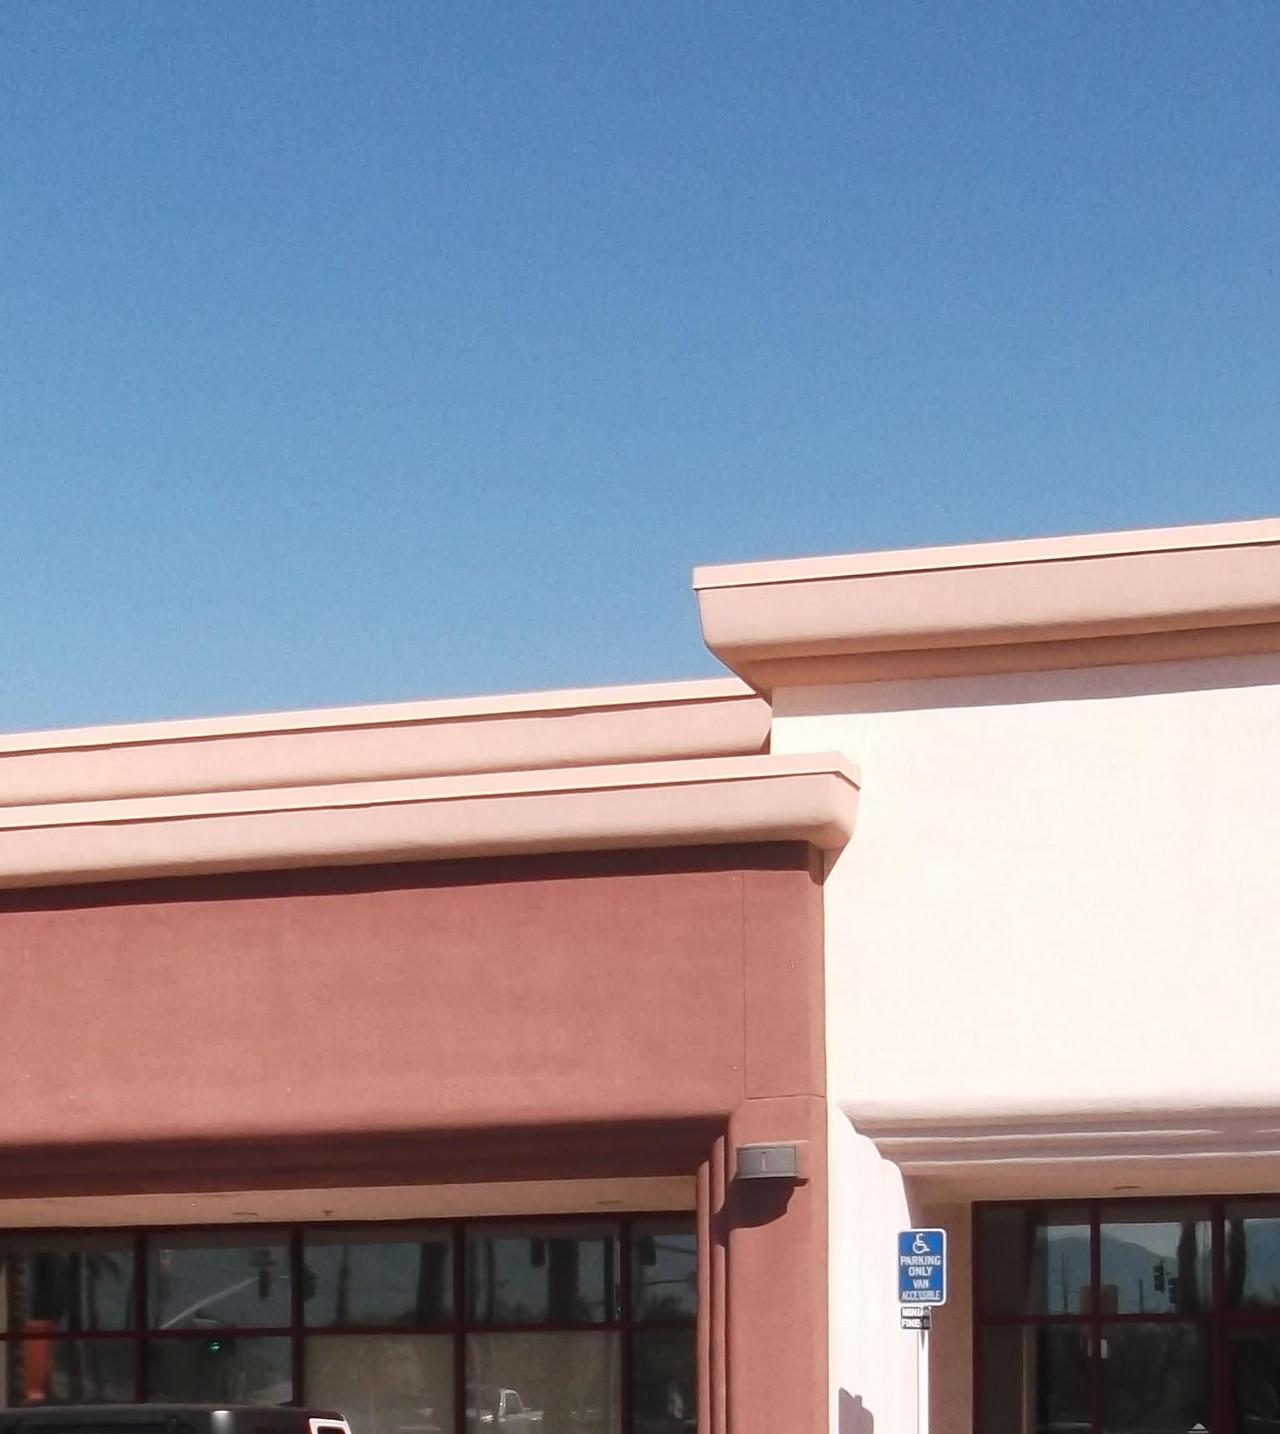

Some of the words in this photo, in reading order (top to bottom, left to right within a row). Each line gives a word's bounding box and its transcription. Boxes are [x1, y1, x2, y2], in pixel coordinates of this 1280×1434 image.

[900, 1255, 941, 1266] PARKING
[908, 1266, 933, 1277] ONLY
[912, 1279, 930, 1289] VAN
[901, 1290, 940, 1300] ACCESSIBLE
